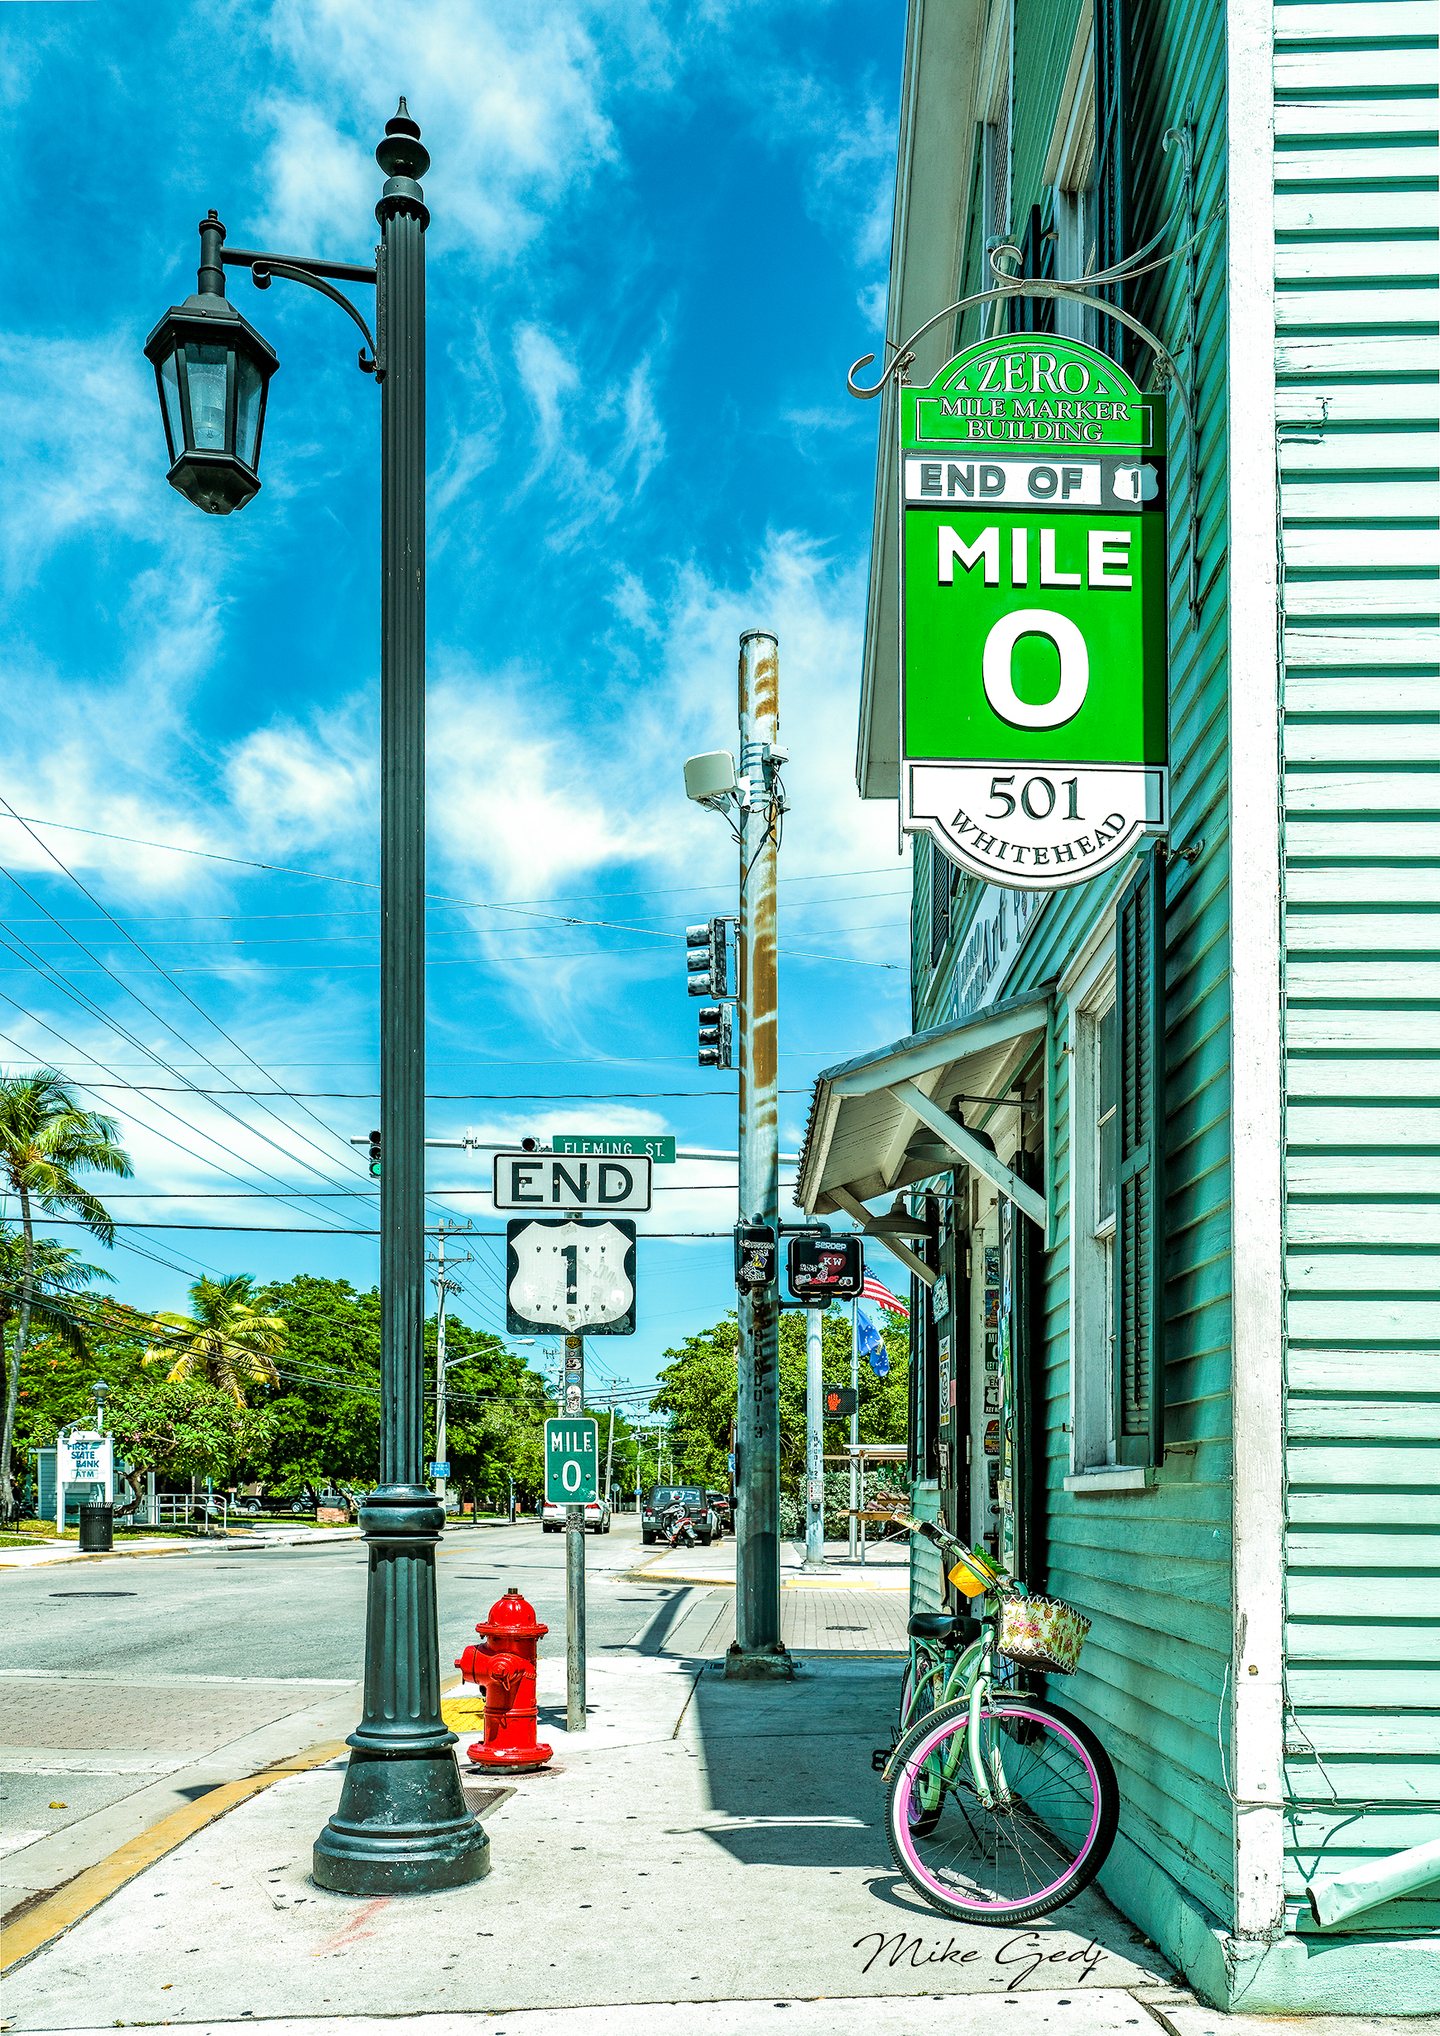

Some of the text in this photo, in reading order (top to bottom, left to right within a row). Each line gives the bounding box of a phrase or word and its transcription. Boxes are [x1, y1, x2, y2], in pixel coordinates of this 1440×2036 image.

[977, 351, 1090, 395] ZERO
[939, 396, 1130, 421] MILE MARKER
[966, 419, 1103, 441] BUILDING
[920, 463, 1139, 500] END OF 1
[937, 525, 1133, 591] MILE
[985, 774, 1086, 821] 501
[950, 809, 1126, 865] WHITEHEAD
[564, 1142, 633, 1154] FLEMING
[511, 1162, 634, 1203] END
[561, 1245, 577, 1304] 1
[67, 1442, 90, 1451] FIRST
[71, 1451, 95, 1460] STATE
[551, 1431, 593, 1453] MILE
[76, 1460, 100, 1468] BANK
[76, 1470, 95, 1478] ATM
[562, 1460, 582, 1492] 0
